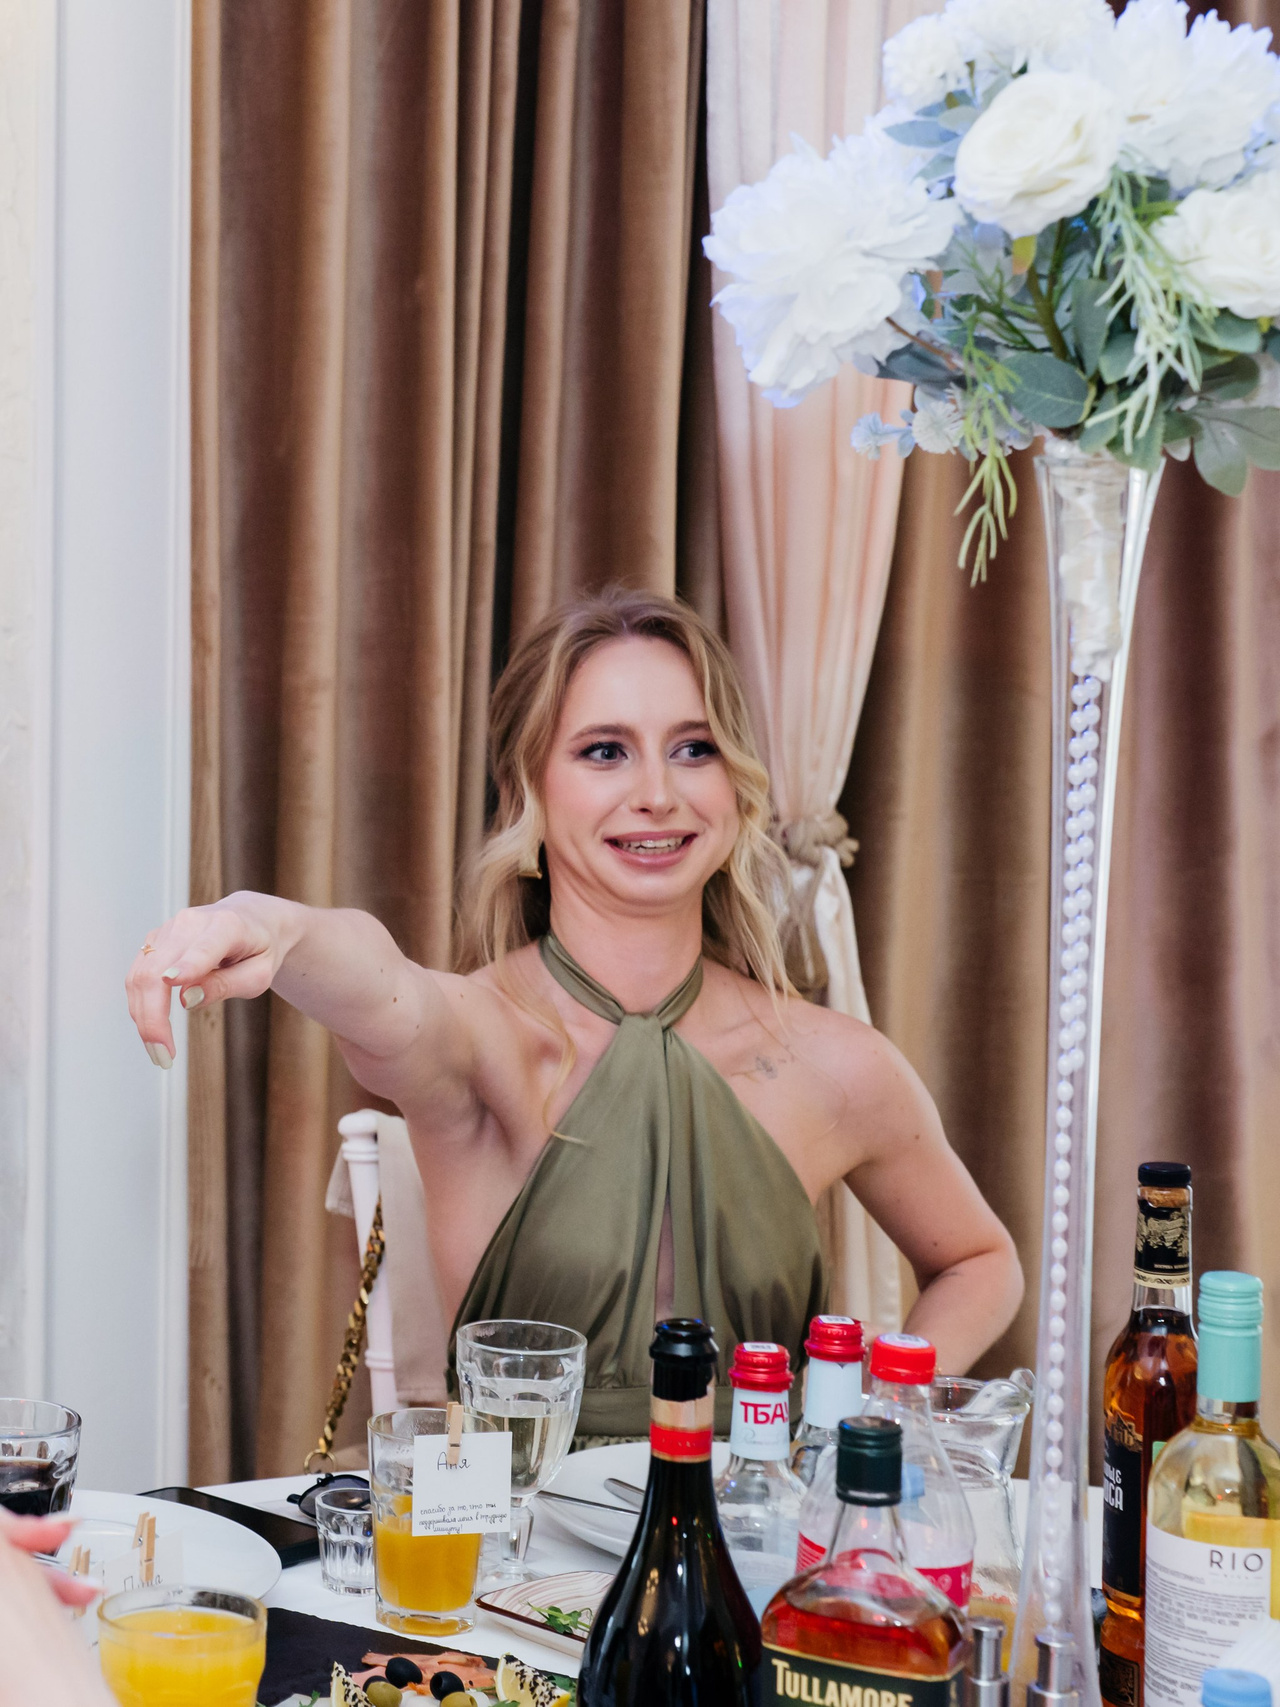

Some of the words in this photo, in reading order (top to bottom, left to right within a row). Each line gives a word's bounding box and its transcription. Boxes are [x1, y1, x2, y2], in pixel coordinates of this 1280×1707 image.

[420, 1503, 446, 1516] спасибо
[447, 1506, 456, 1517] за
[1209, 1549, 1264, 1573] RIO
